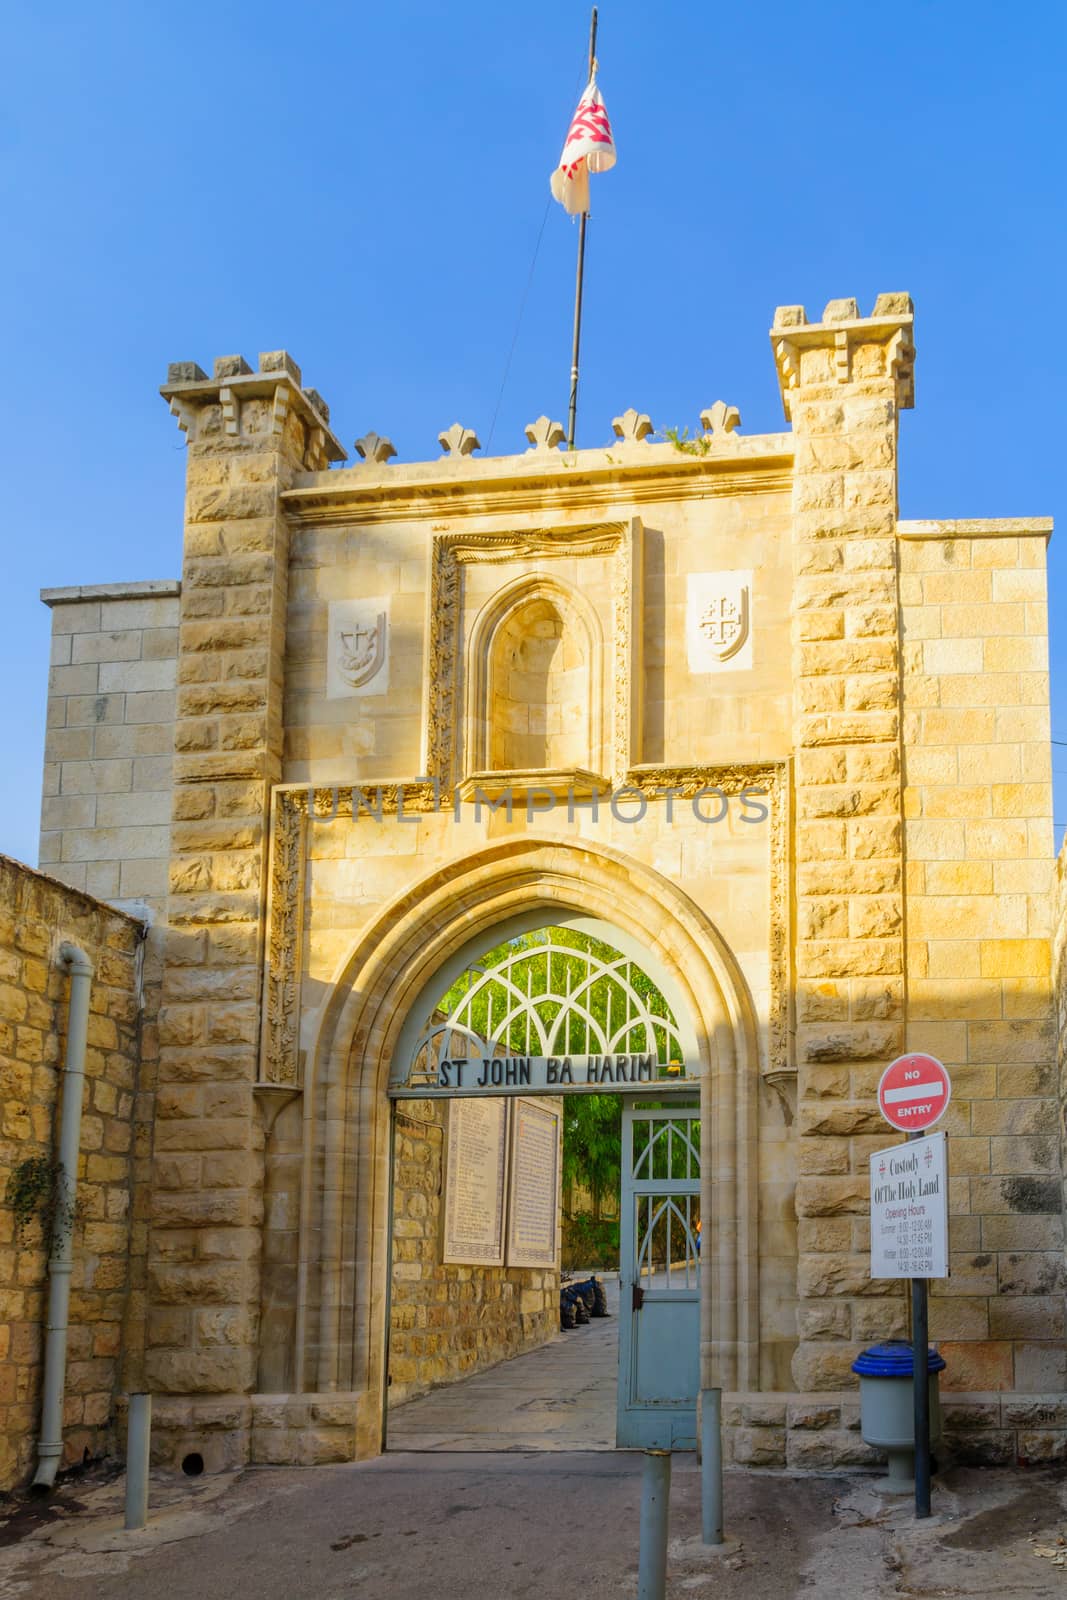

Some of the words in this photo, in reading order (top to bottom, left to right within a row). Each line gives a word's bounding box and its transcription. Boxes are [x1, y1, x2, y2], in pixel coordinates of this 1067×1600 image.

[440, 1060, 468, 1087] ST
[477, 1058, 531, 1086] JOHN
[547, 1057, 573, 1084] BA
[587, 1055, 653, 1083] HARIM
[904, 1070, 920, 1081] NO
[897, 1103, 932, 1117] ENTRY
[889, 1152, 919, 1176] Custody
[898, 1180, 916, 1203] Holy
[919, 1174, 940, 1197] Land
[885, 1208, 907, 1220] Opening
[908, 1205, 926, 1216] Hours
